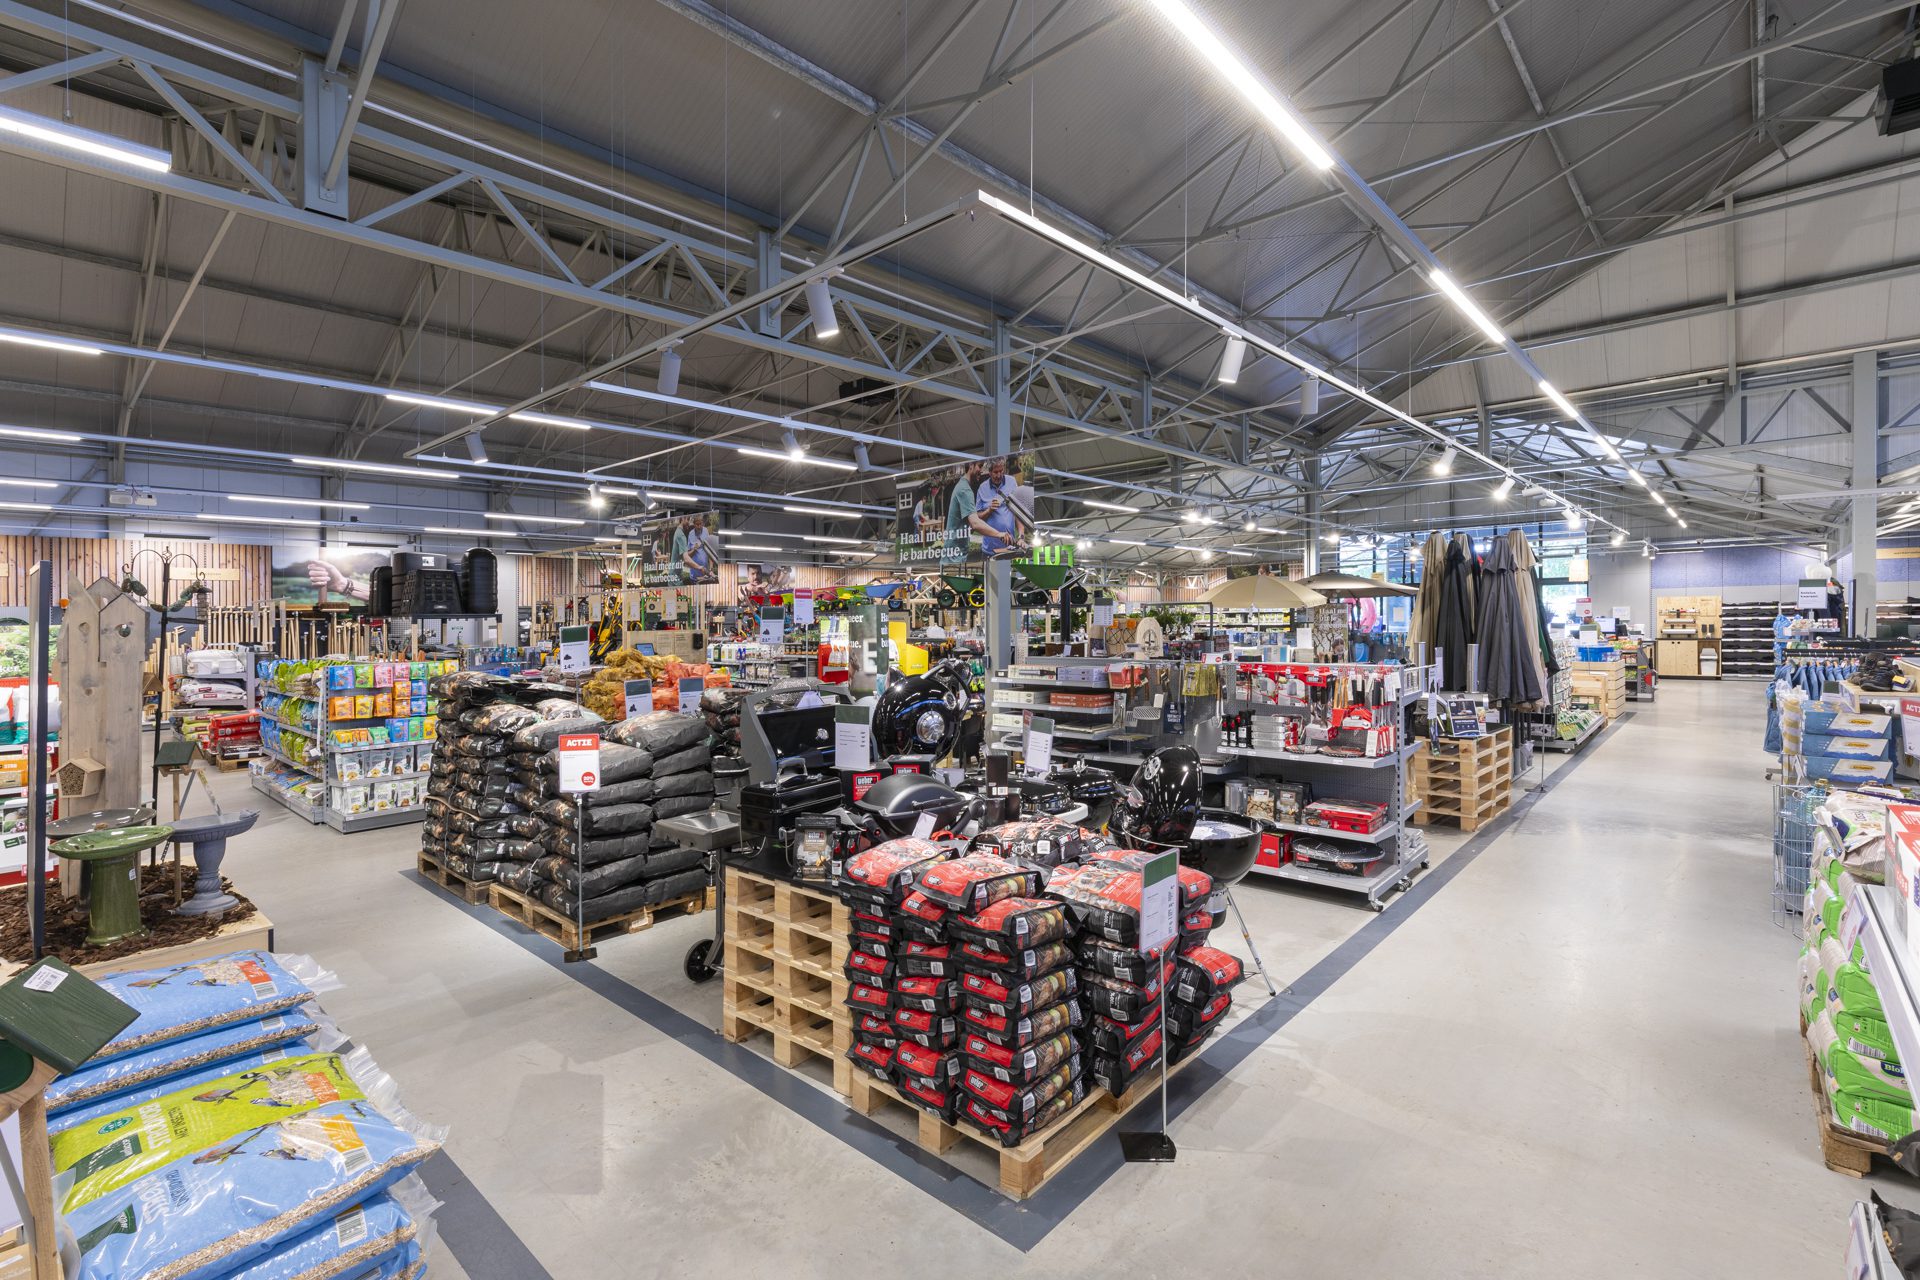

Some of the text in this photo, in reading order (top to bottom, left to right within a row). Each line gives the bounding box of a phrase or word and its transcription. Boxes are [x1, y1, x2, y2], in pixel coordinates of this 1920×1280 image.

[900, 525, 972, 545] Haal meer uit
[899, 546, 963, 563] je barbecue.
[644, 562, 657, 571] Haal
[658, 561, 674, 570] meer
[566, 739, 592, 747] ACTIE
[857, 776, 872, 784] weber
